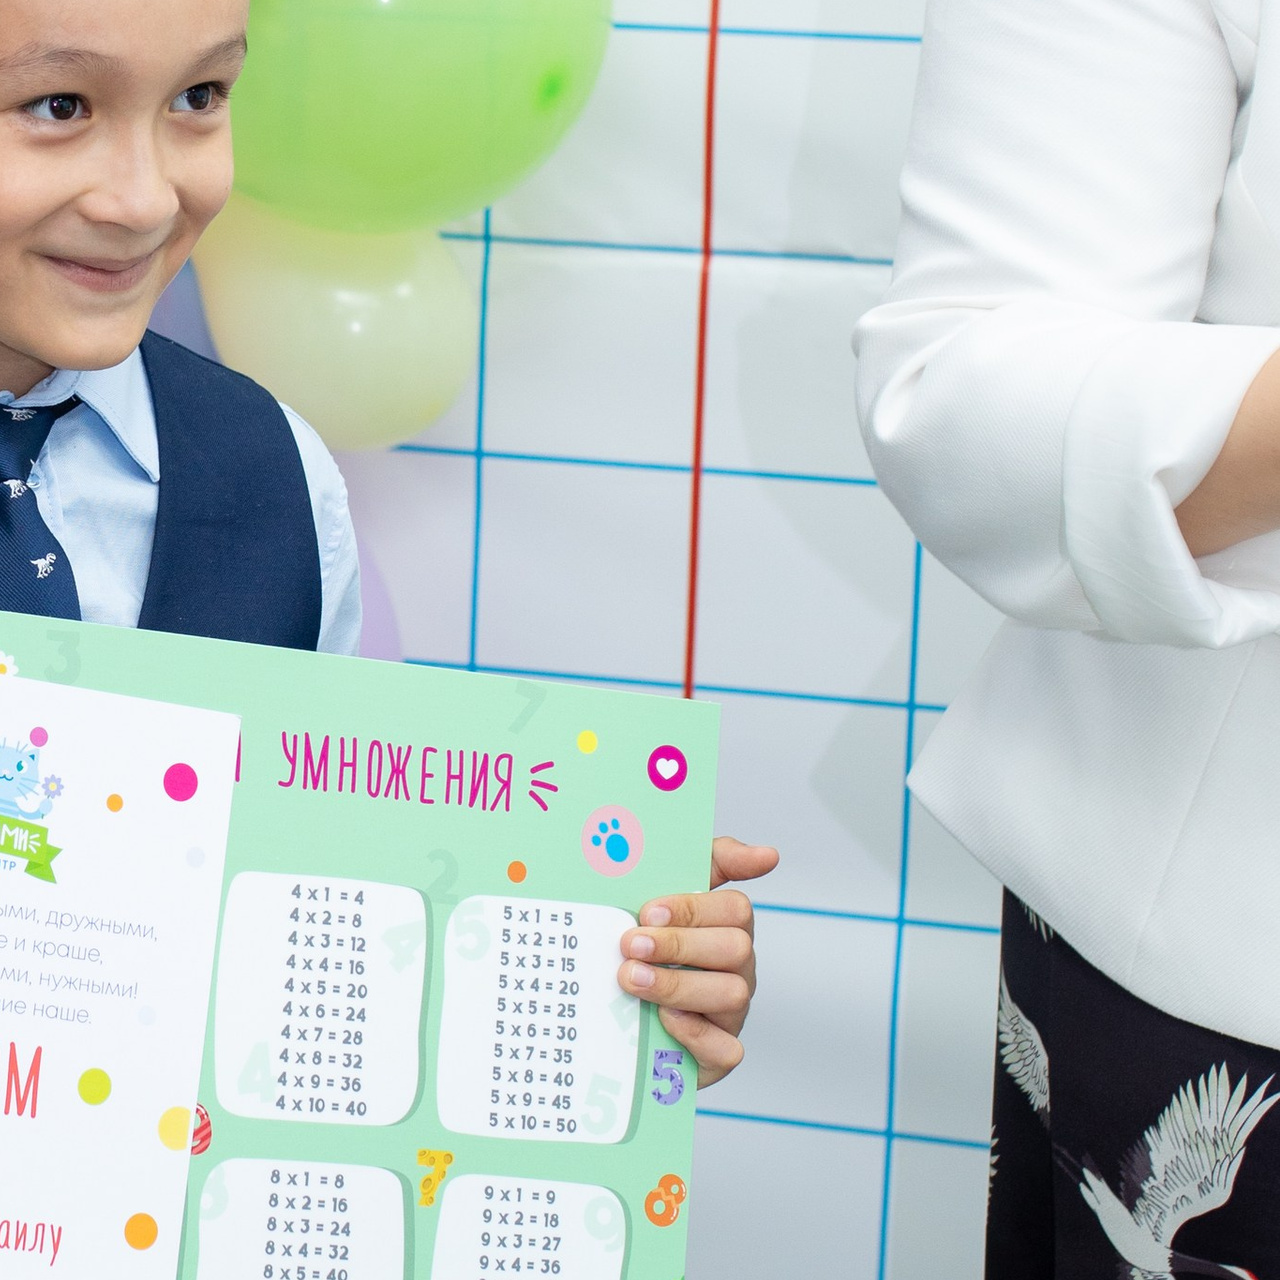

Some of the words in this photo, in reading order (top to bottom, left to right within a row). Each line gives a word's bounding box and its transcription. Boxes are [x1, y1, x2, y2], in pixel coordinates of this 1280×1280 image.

[278, 731, 514, 812] УМНОЖЕНИЯ
[291, 884, 301, 898] 4
[324, 886, 329, 901] 1
[354, 890, 363, 905] 4
[44, 910, 157, 941] дружными,
[287, 930, 297, 945] 4
[320, 933, 330, 948] 3
[351, 936, 365, 952] 12
[502, 928, 510, 942] 5
[533, 931, 542, 946] 2
[562, 934, 577, 949] 10
[13, 937, 25, 951] и
[32, 939, 102, 965] краше,
[39, 972, 137, 999] нужными!
[284, 977, 294, 992] 4
[317, 980, 326, 994] 5
[346, 983, 367, 998] 20
[499, 974, 507, 988] 5
[530, 977, 539, 992] 4
[558, 980, 579, 995] 20
[32, 1003, 91, 1024] наше.
[280, 1024, 290, 1039] 4
[314, 1027, 322, 1041] 7
[342, 1029, 362, 1045] 28
[495, 1020, 504, 1034] 5
[527, 1023, 536, 1037] 6
[556, 1025, 576, 1041] 30
[277, 1071, 287, 1086] 4
[310, 1074, 320, 1088] 9
[340, 1076, 361, 1092] 36
[492, 1066, 501, 1080] 5
[523, 1069, 533, 1083] 8
[553, 1071, 573, 1086] 40
[651, 1049, 685, 1105] 5
[489, 1112, 498, 1126] 5
[521, 1114, 536, 1130] 10
[556, 1117, 576, 1133] 50
[270, 1169, 280, 1183] 8
[304, 1171, 309, 1186] 1
[334, 1174, 344, 1188] 8
[418, 1148, 454, 1207] 7
[644, 1174, 687, 1227] 8
[266, 1216, 276, 1231] 8
[300, 1218, 309, 1233] 3
[330, 1221, 350, 1236] 24
[482, 1208, 492, 1223] 9
[514, 1211, 523, 1225] 2
[543, 1212, 558, 1227] 18
[263, 1264, 273, 1278] 8
[296, 1266, 305, 1280] 5
[479, 1255, 488, 1269] 9
[511, 1257, 520, 1271] 4
[540, 1259, 560, 1274] 36
